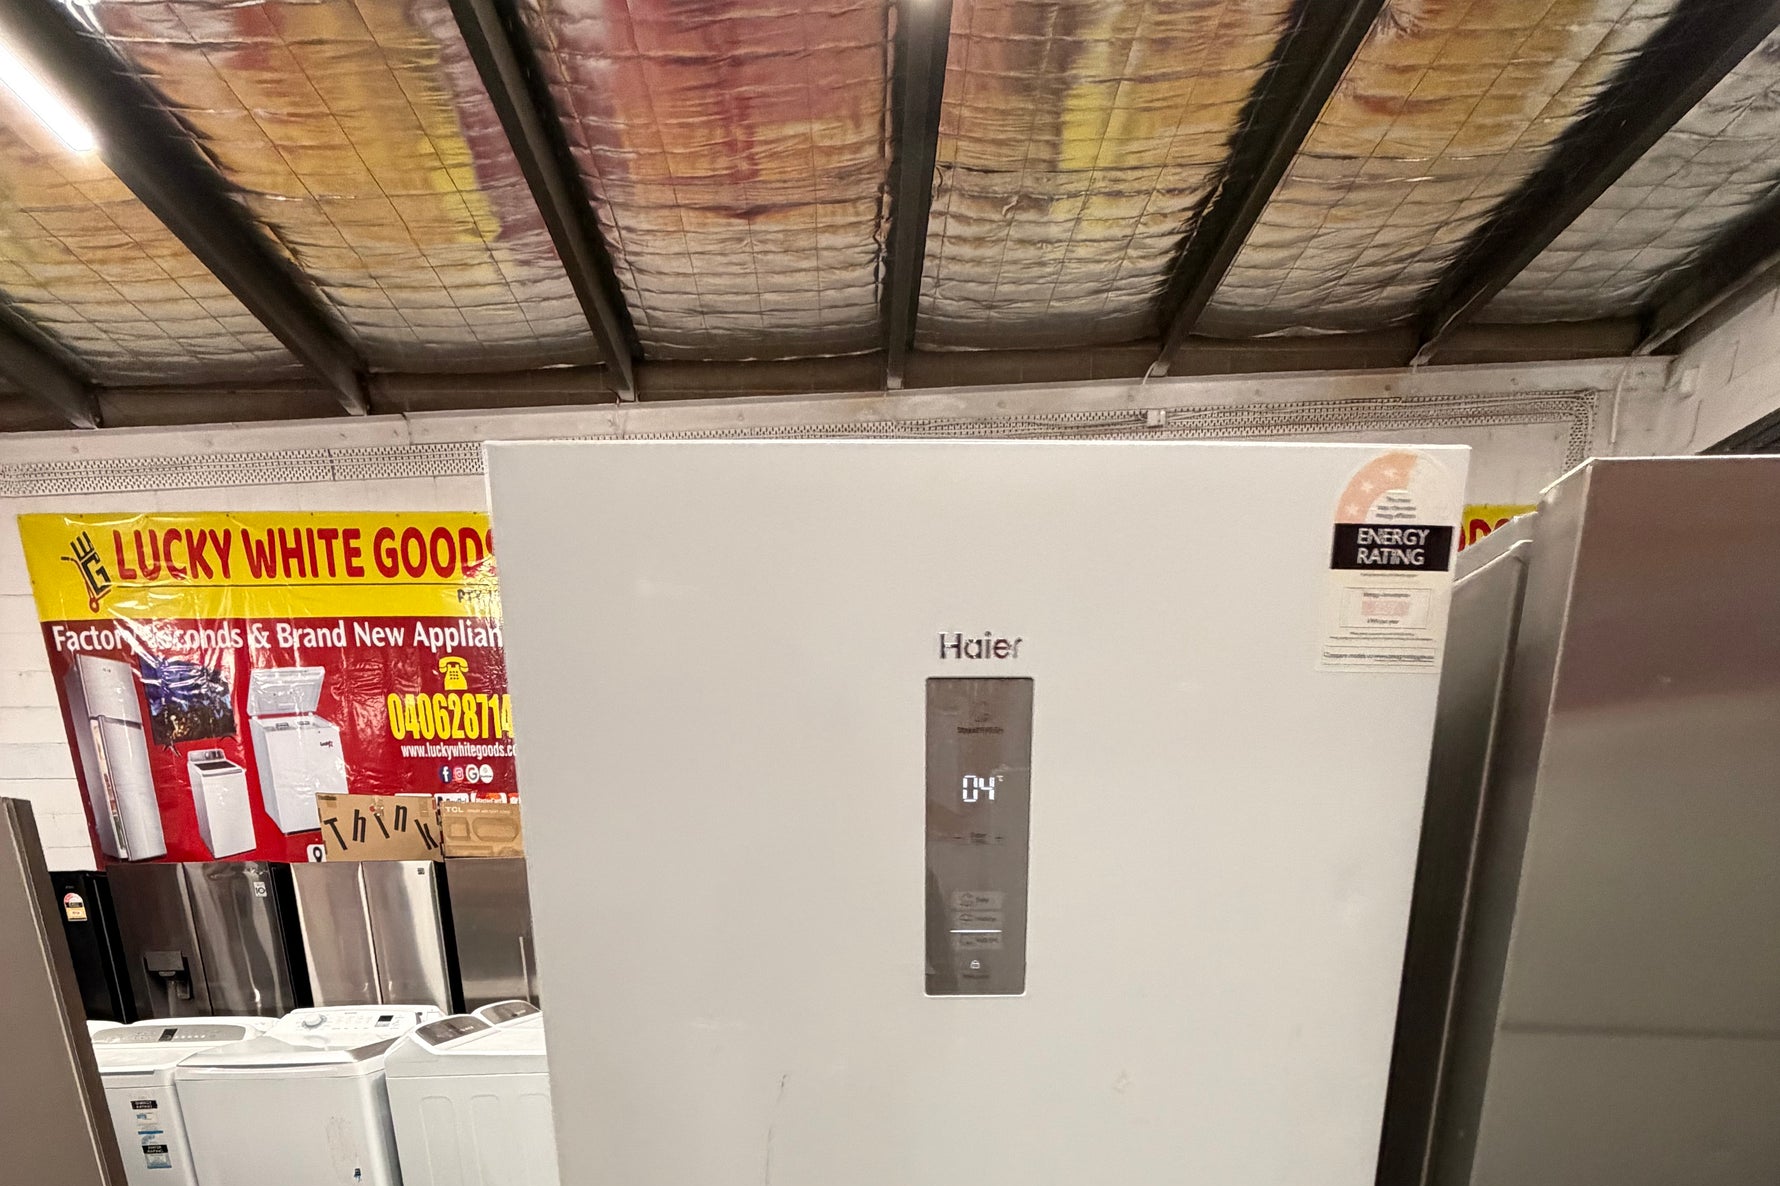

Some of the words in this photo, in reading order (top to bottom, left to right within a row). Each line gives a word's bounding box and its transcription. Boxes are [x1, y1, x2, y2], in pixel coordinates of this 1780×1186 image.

[1356, 527, 1430, 546] ENERGY
[113, 528, 232, 581] LUCKY
[241, 527, 365, 579] WHITE
[1356, 548, 1425, 566] RATING
[251, 622, 272, 649] &
[276, 620, 347, 649] Brand
[353, 621, 405, 648] New
[413, 619, 503, 653] Applian
[938, 630, 1023, 660] Haier
[387, 692, 515, 740] 040628714
[963, 775, 995, 802] 04
